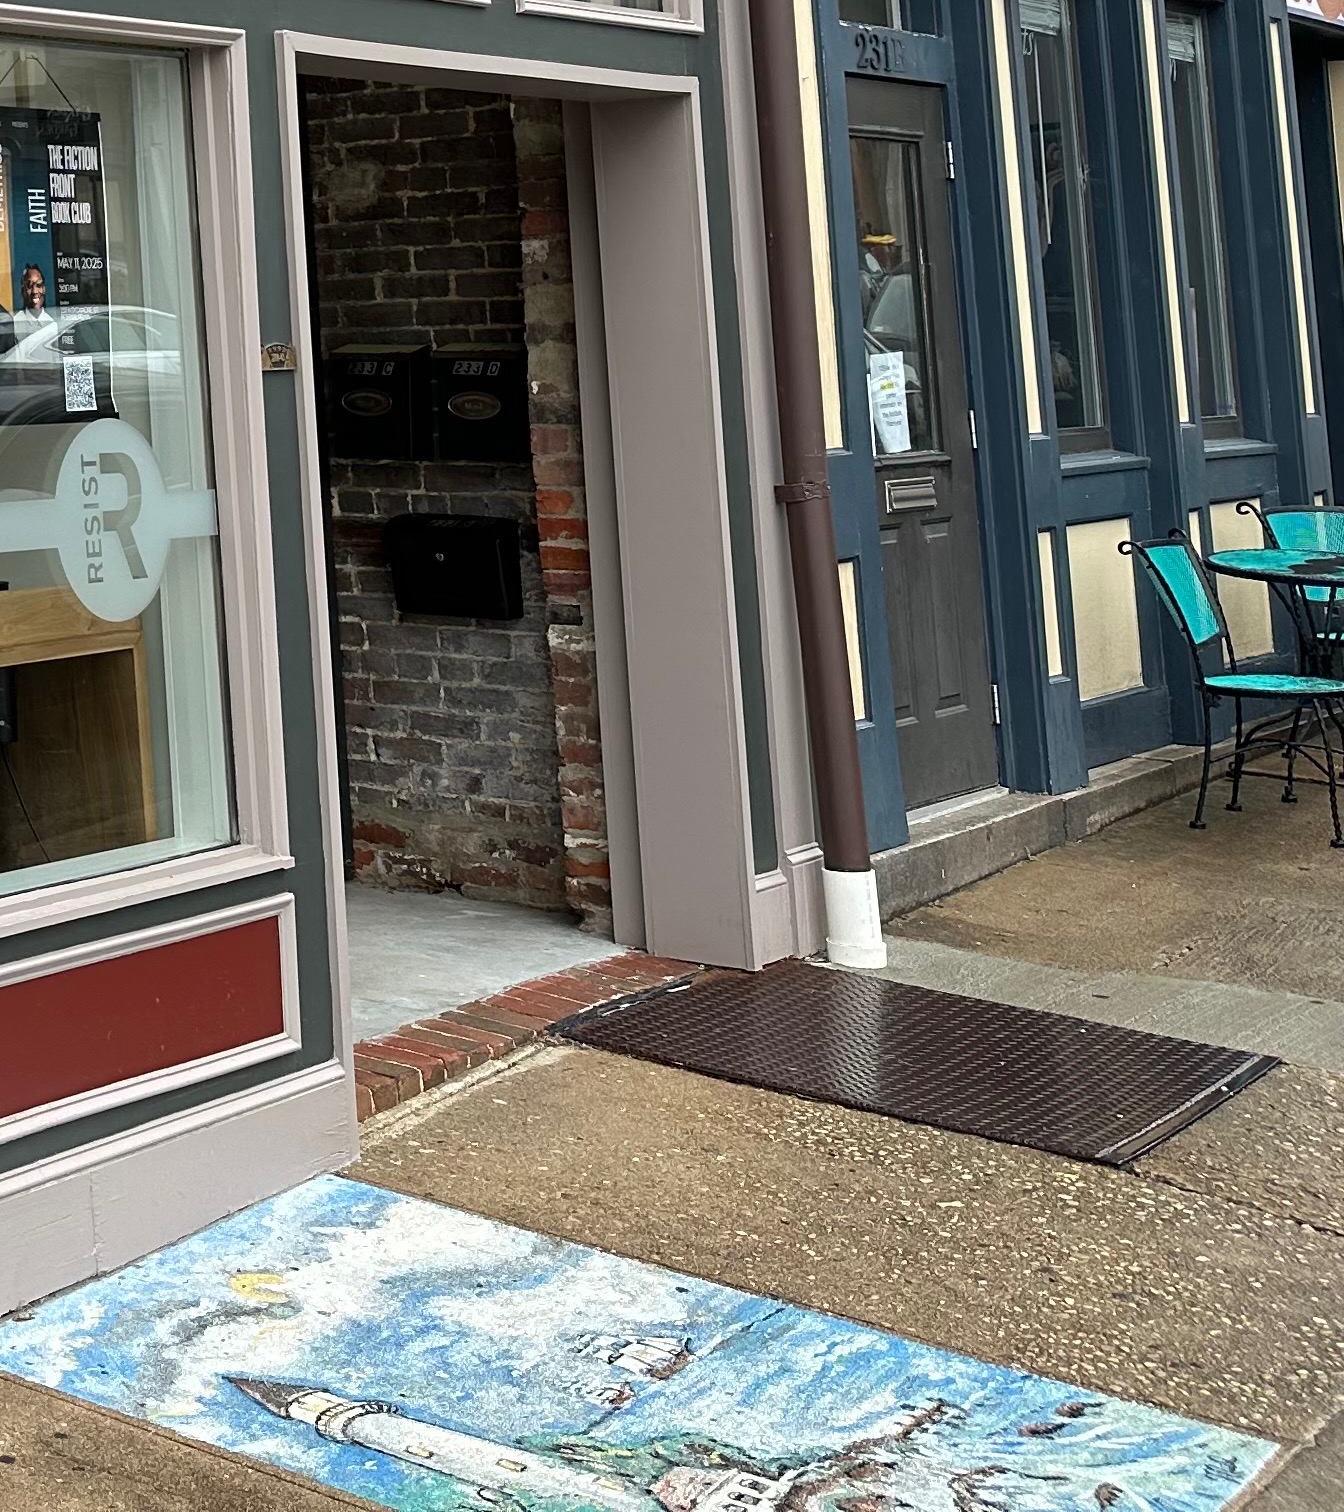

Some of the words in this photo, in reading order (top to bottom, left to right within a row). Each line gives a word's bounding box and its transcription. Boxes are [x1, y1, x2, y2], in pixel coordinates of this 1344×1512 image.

[47, 144, 63, 170] THE
[63, 145, 99, 171] FICTION
[49, 172, 75, 199] FRONT
[27, 188, 48, 233] FAITH
[50, 201, 71, 224] BOOK
[71, 201, 91, 224] CLUB
[57, 256, 73, 269] MAY
[81, 257, 103, 269] 2025
[349, 362, 377, 375] 233
[383, 362, 394, 375] C
[454, 362, 482, 375] 233
[488, 362, 499, 375] D
[79, 453, 105, 584] RESIST
[98, 451, 149, 580] R
